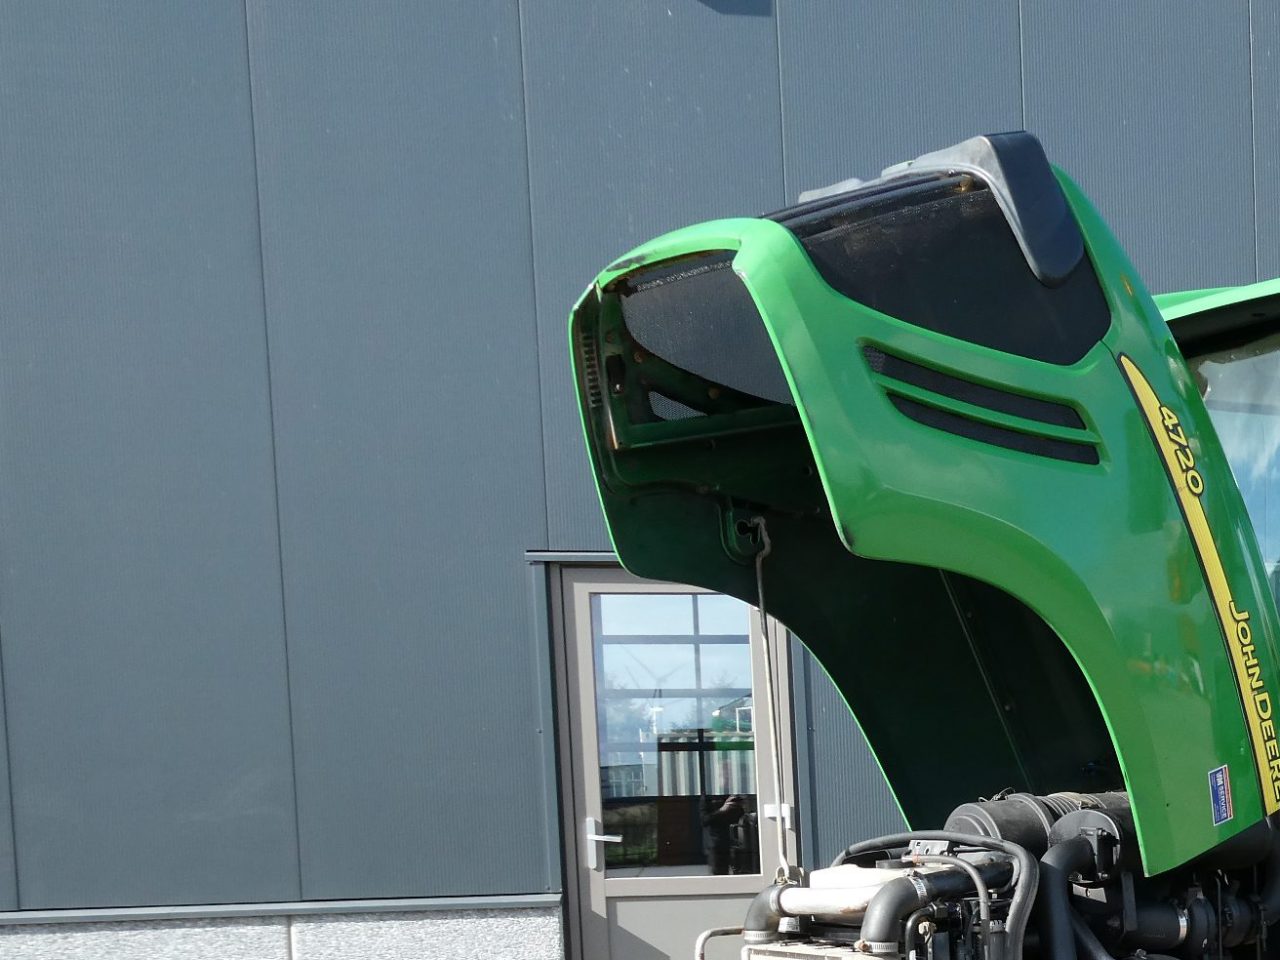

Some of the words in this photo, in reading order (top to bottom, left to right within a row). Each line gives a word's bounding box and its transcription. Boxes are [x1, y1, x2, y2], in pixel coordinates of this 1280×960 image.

[1159, 406, 1204, 496] 4720
[1229, 601, 1264, 692] JOHN
[1219, 786, 1227, 819] SERVICE
